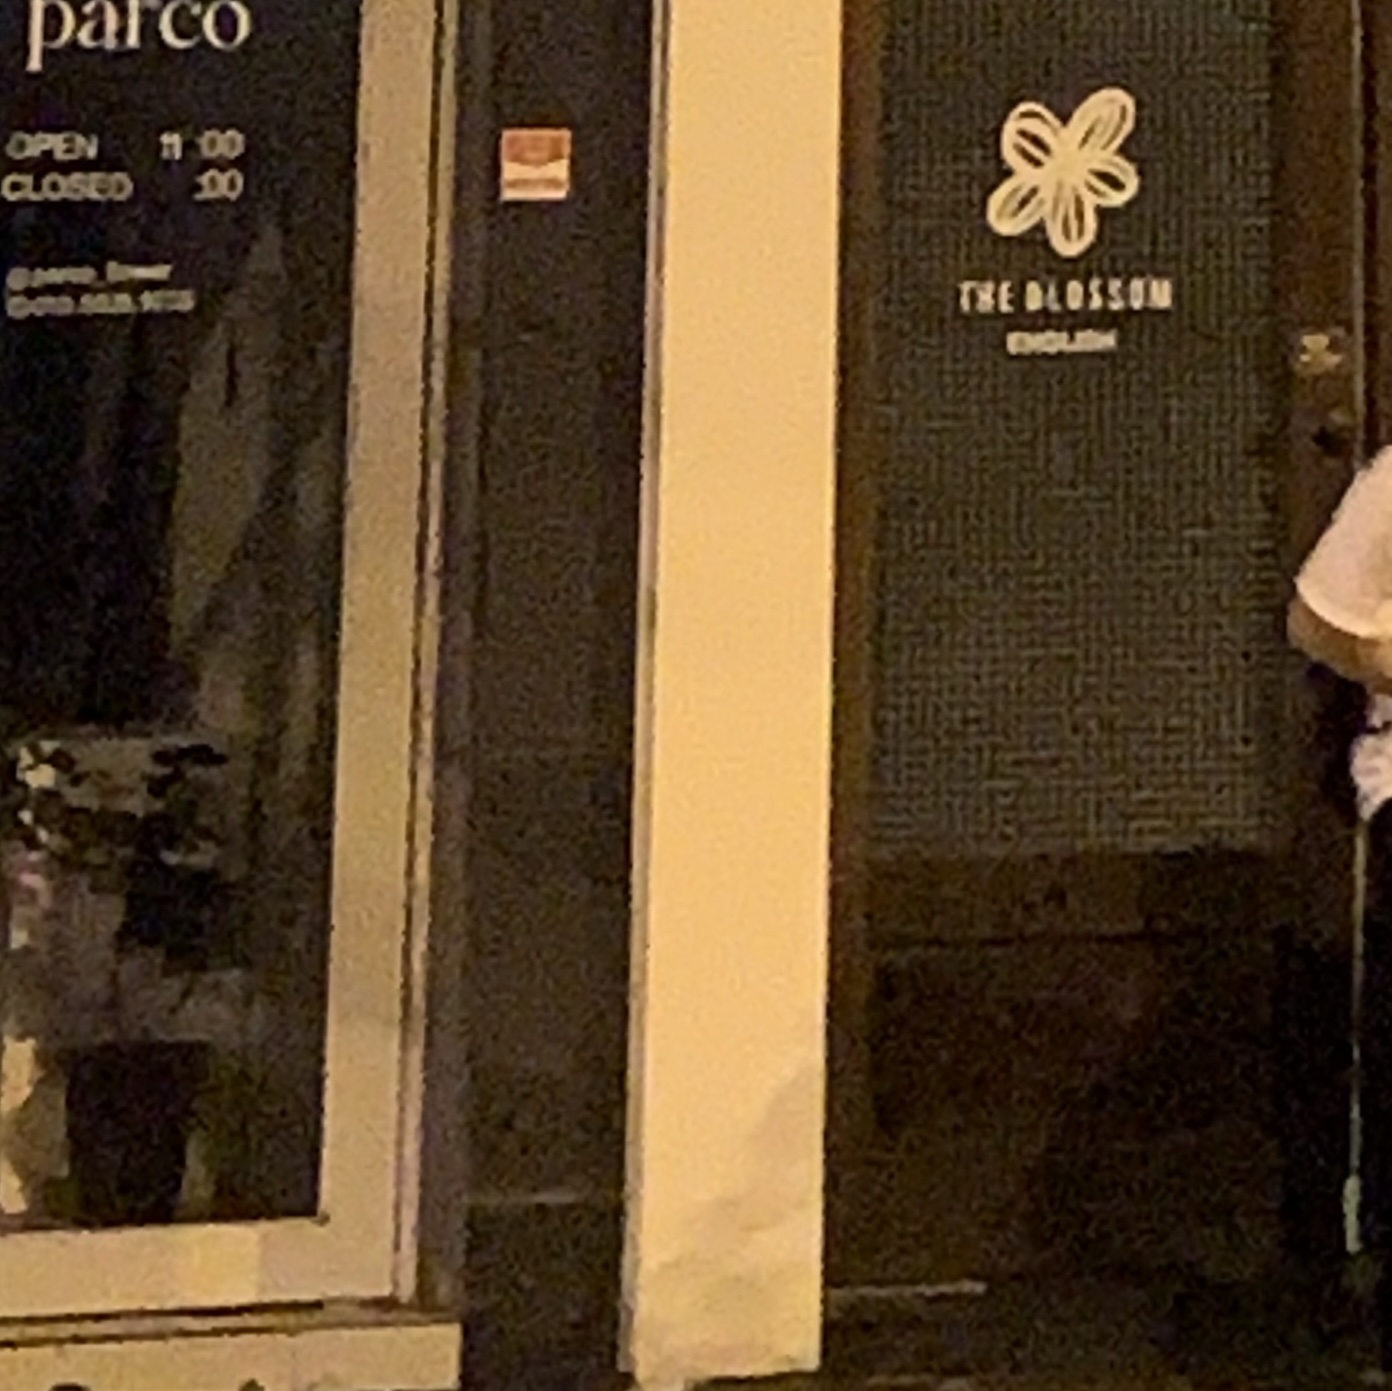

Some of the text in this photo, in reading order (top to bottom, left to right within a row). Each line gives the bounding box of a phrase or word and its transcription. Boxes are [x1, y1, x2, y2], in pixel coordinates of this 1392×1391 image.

[6, 130, 99, 161] OPEN
[0, 171, 135, 202] CLOSED
[957, 279, 1015, 314] THE
